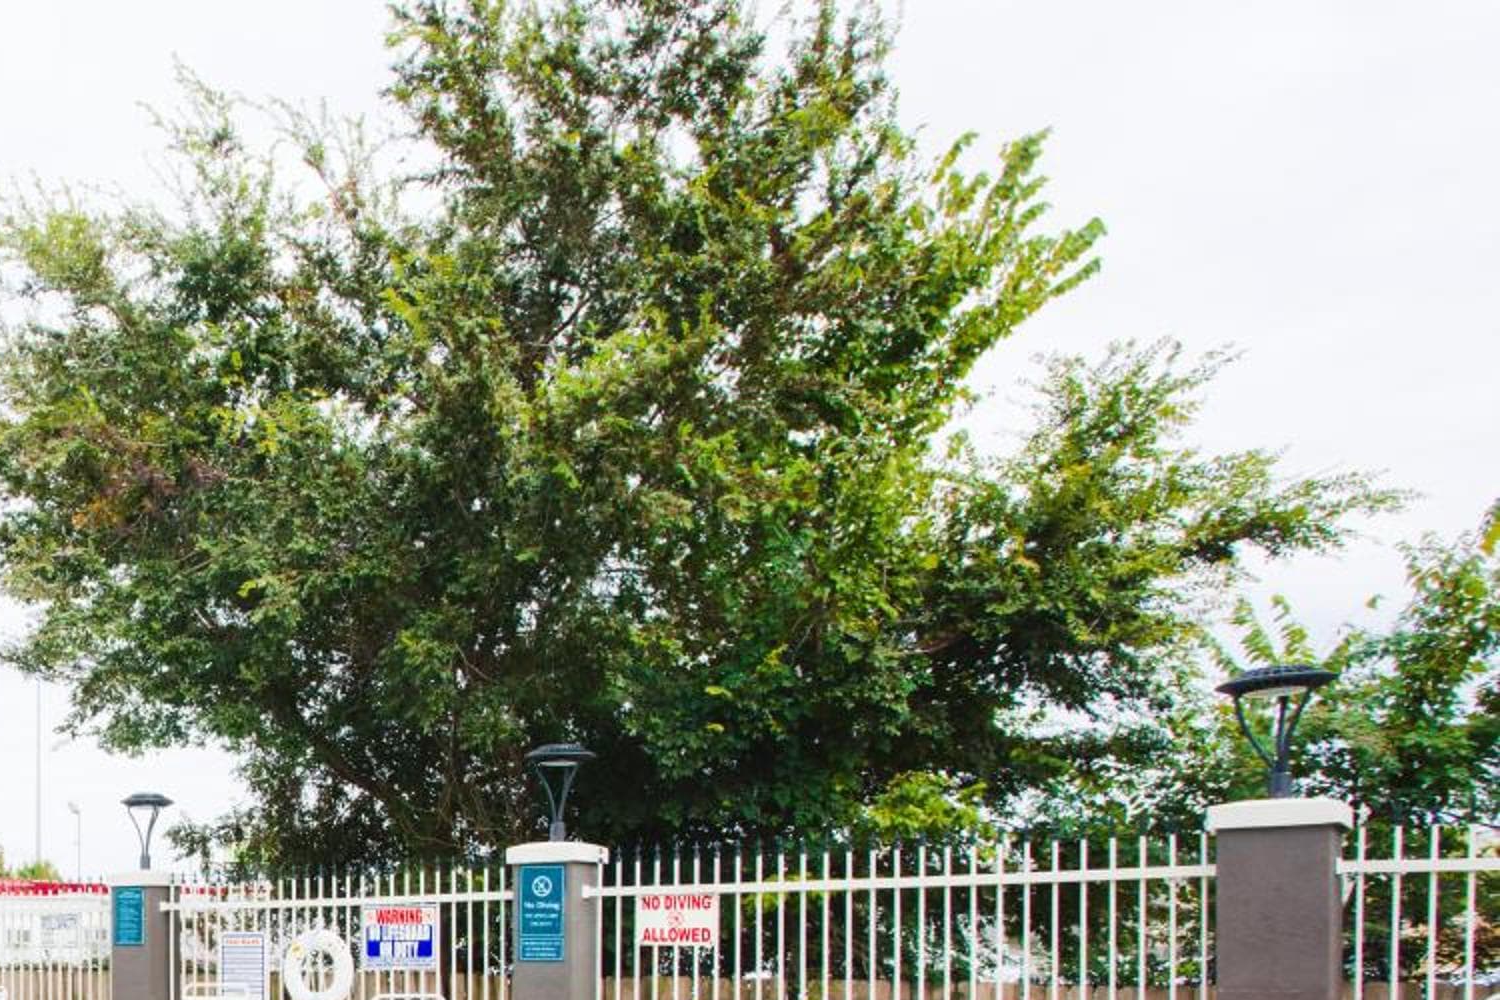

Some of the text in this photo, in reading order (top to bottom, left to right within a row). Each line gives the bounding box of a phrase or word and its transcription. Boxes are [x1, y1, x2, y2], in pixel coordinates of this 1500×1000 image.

[642, 896, 712, 910] NO DIVING
[376, 909, 422, 925] WARNING
[643, 928, 711, 942] ALLOWED
